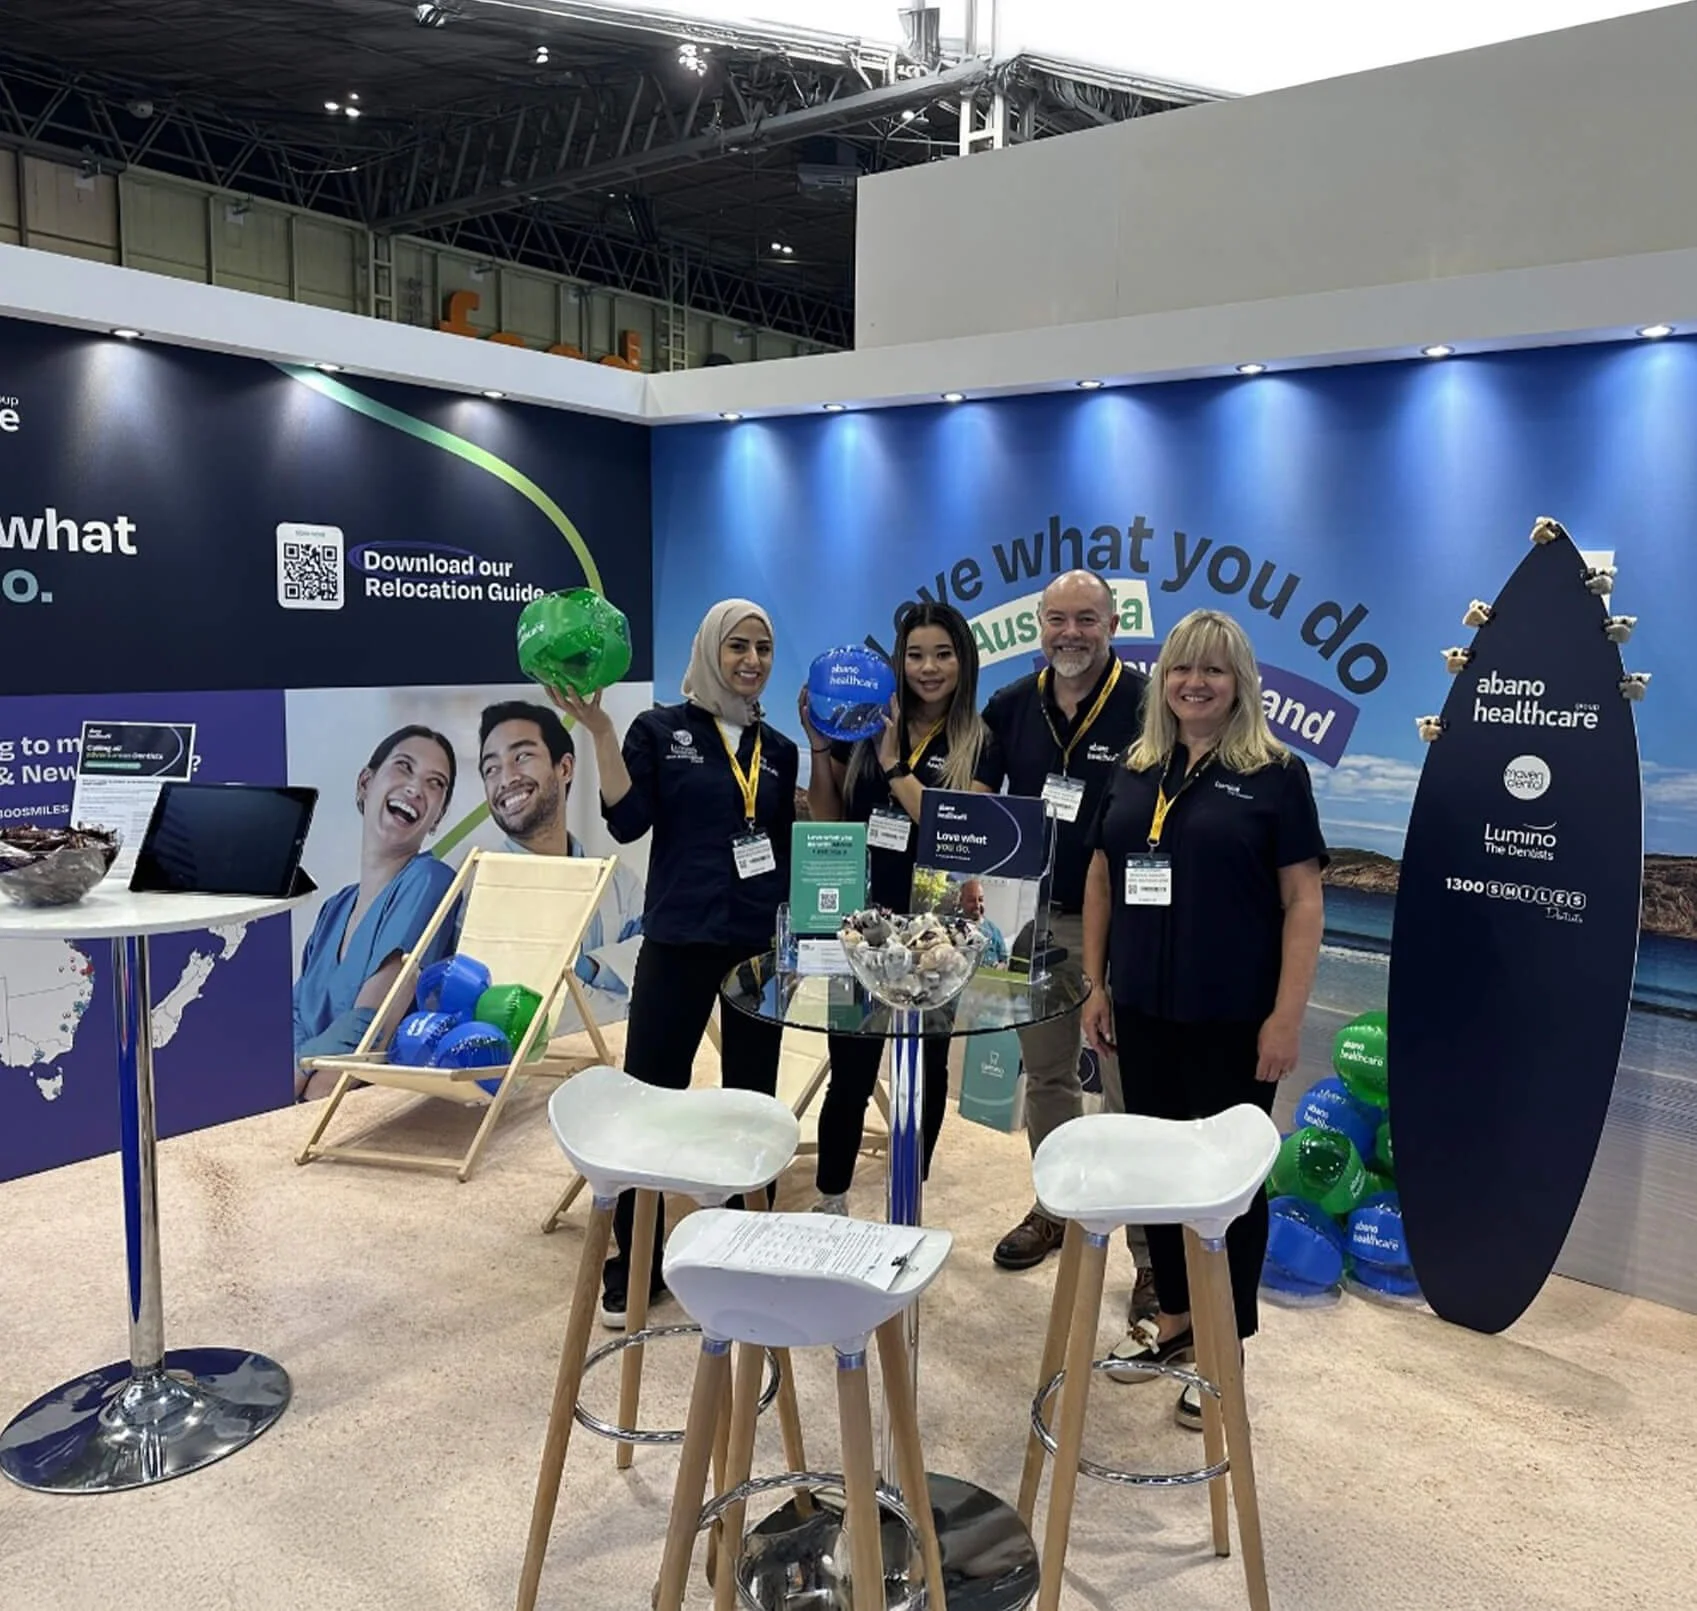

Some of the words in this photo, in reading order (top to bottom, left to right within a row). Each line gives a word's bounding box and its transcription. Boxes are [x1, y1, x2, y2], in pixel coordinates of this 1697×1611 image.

[0, 508, 137, 555] what
[363, 550, 475, 575] Download
[479, 560, 513, 577] our
[2, 569, 53, 603] o.
[365, 578, 483, 600] Relocation
[487, 583, 544, 602] Guide
[992, 515, 1154, 584] what
[1160, 531, 1303, 620] you
[1300, 603, 1389, 695] do
[831, 663, 860, 674] abano
[829, 674, 880, 690] healthcare
[1476, 670, 1546, 696] abano
[1473, 698, 1599, 729] healthcare
[21, 737, 50, 755] to
[22, 764, 76, 784] New
[1484, 823, 1557, 848] Lumino
[1484, 841, 1506, 855] The
[1507, 844, 1555, 861] Dentists
